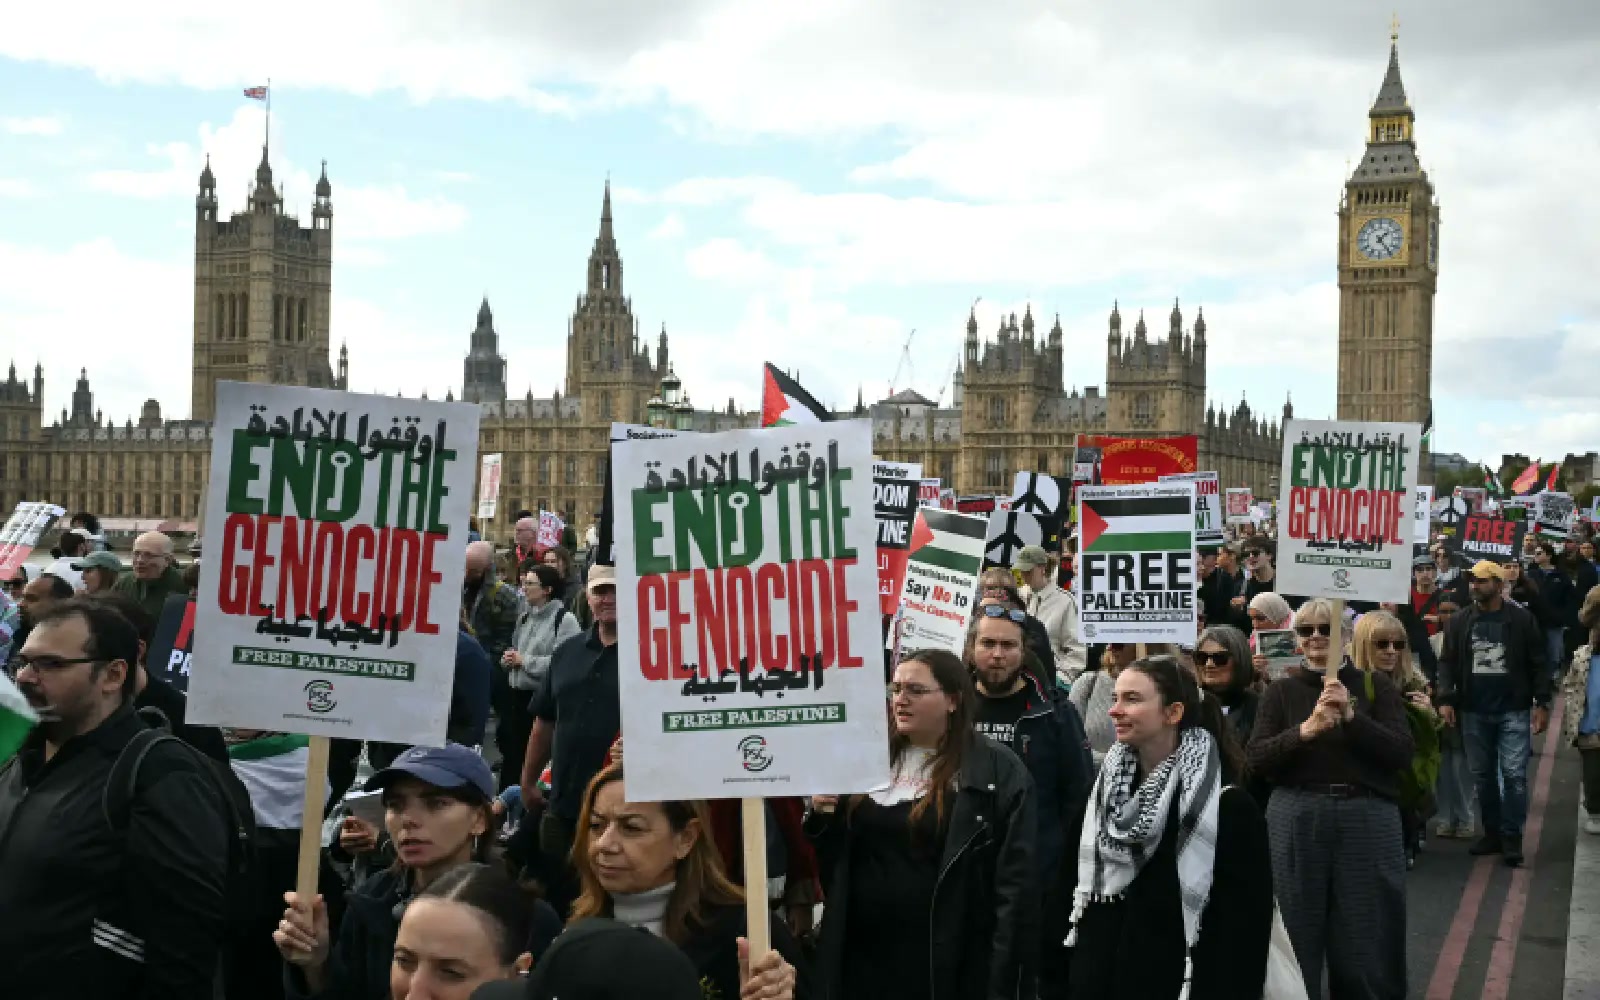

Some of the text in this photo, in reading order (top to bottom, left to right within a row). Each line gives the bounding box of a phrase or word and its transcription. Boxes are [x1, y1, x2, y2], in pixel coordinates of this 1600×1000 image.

[226, 429, 364, 523] END
[374, 448, 457, 536] THE
[1291, 443, 1410, 493] END THE
[631, 467, 858, 576] END THE
[1287, 487, 1407, 545] GENOCIDE
[1464, 517, 1517, 546] FREE
[218, 512, 450, 634] GENOCIDE
[906, 577, 930, 601] Say
[953, 592, 968, 609] to
[1082, 552, 1193, 591] FREE
[637, 557, 864, 681] GENOCIDE
[1082, 592, 1194, 611] PALESTINE
[239, 648, 409, 677] FREE PALESTINE
[669, 706, 839, 729] FREE PALESTINE
